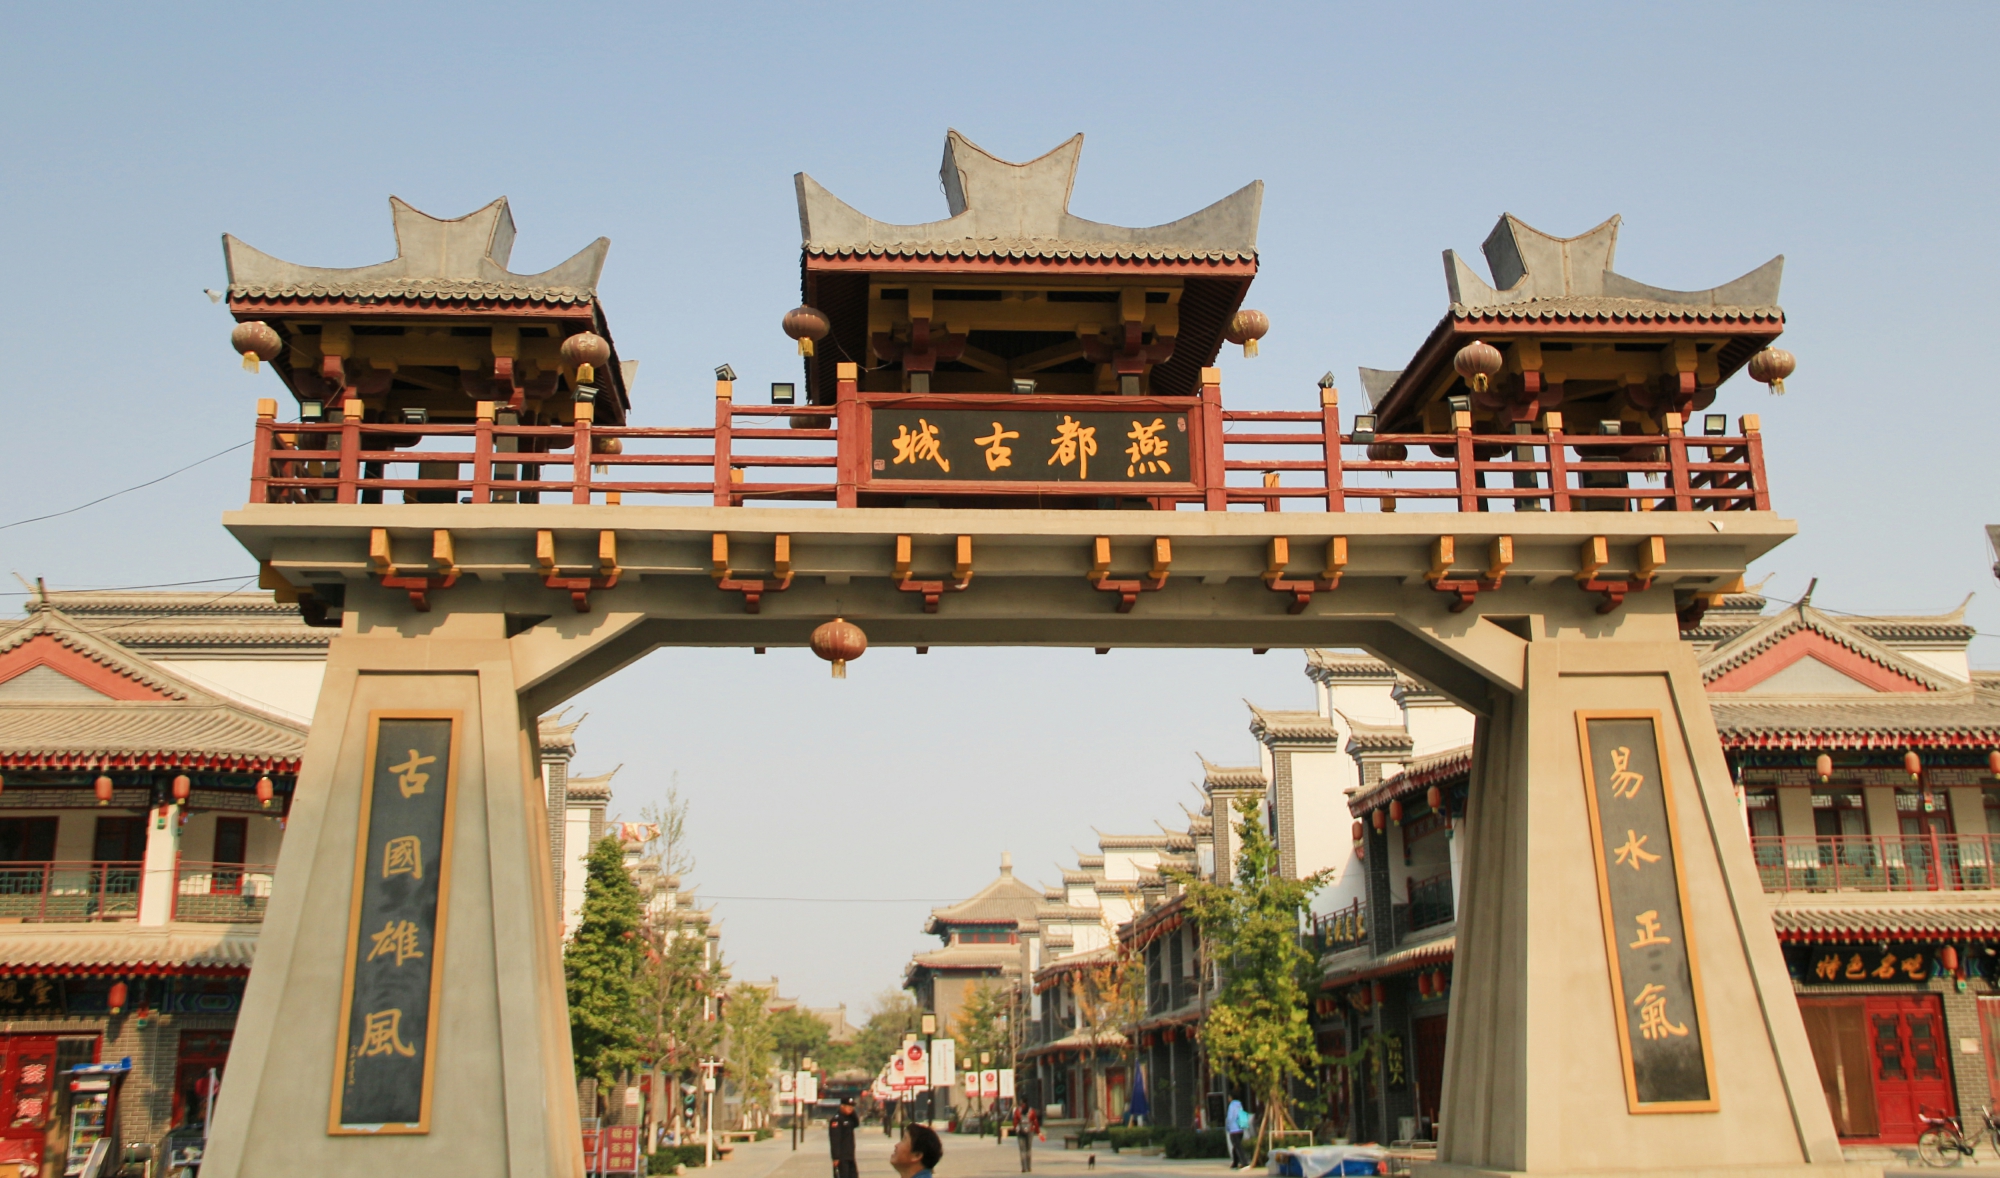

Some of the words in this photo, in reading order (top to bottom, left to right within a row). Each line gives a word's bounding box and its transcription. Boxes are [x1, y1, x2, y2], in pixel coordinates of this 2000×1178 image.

[892, 415, 1171, 479] 燕都古城
[358, 749, 436, 1058] 古國雄風
[1610, 746, 1688, 1040] 易水正氣
[1816, 953, 1927, 981] 特色名吃
